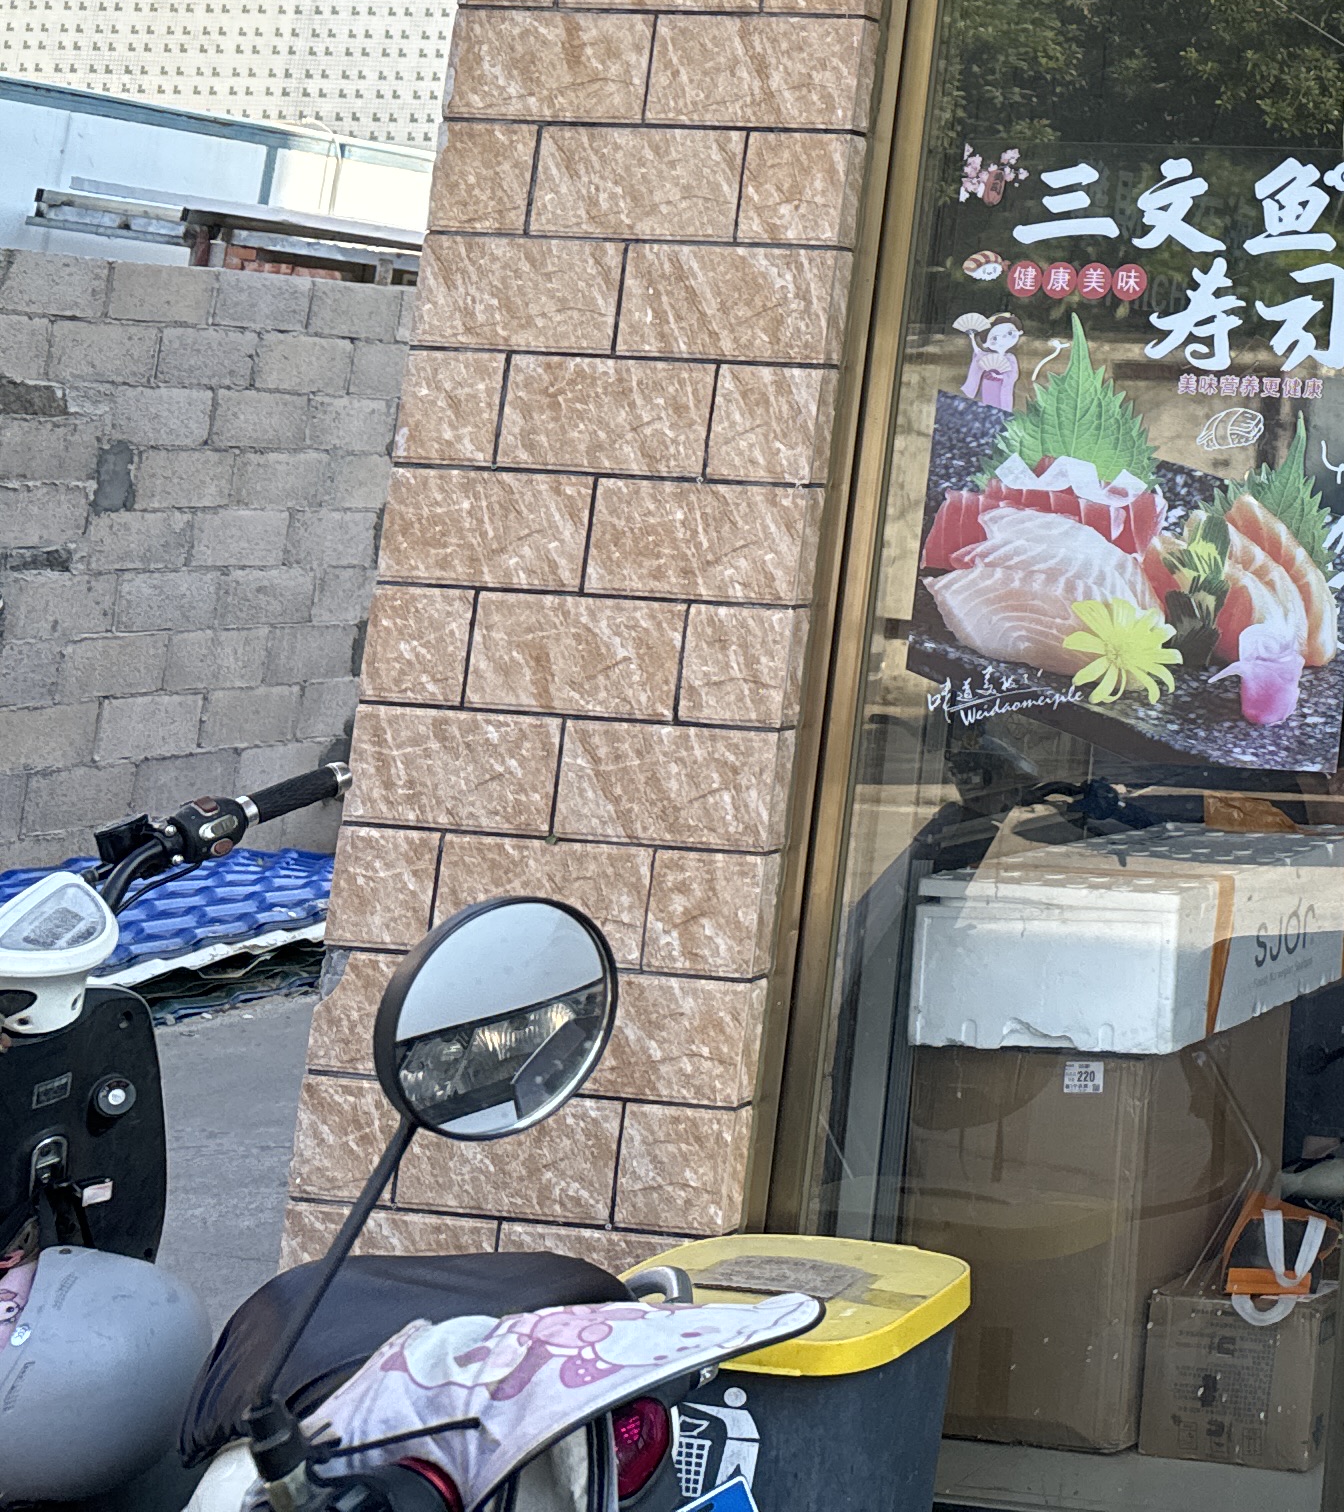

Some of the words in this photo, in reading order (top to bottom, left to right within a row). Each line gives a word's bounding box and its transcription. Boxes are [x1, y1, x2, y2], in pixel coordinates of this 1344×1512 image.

[1012, 157, 1338, 256] 三文鱼
[1012, 265, 1142, 294] 健康美味
[1178, 373, 1324, 399] 美味营养更健康
